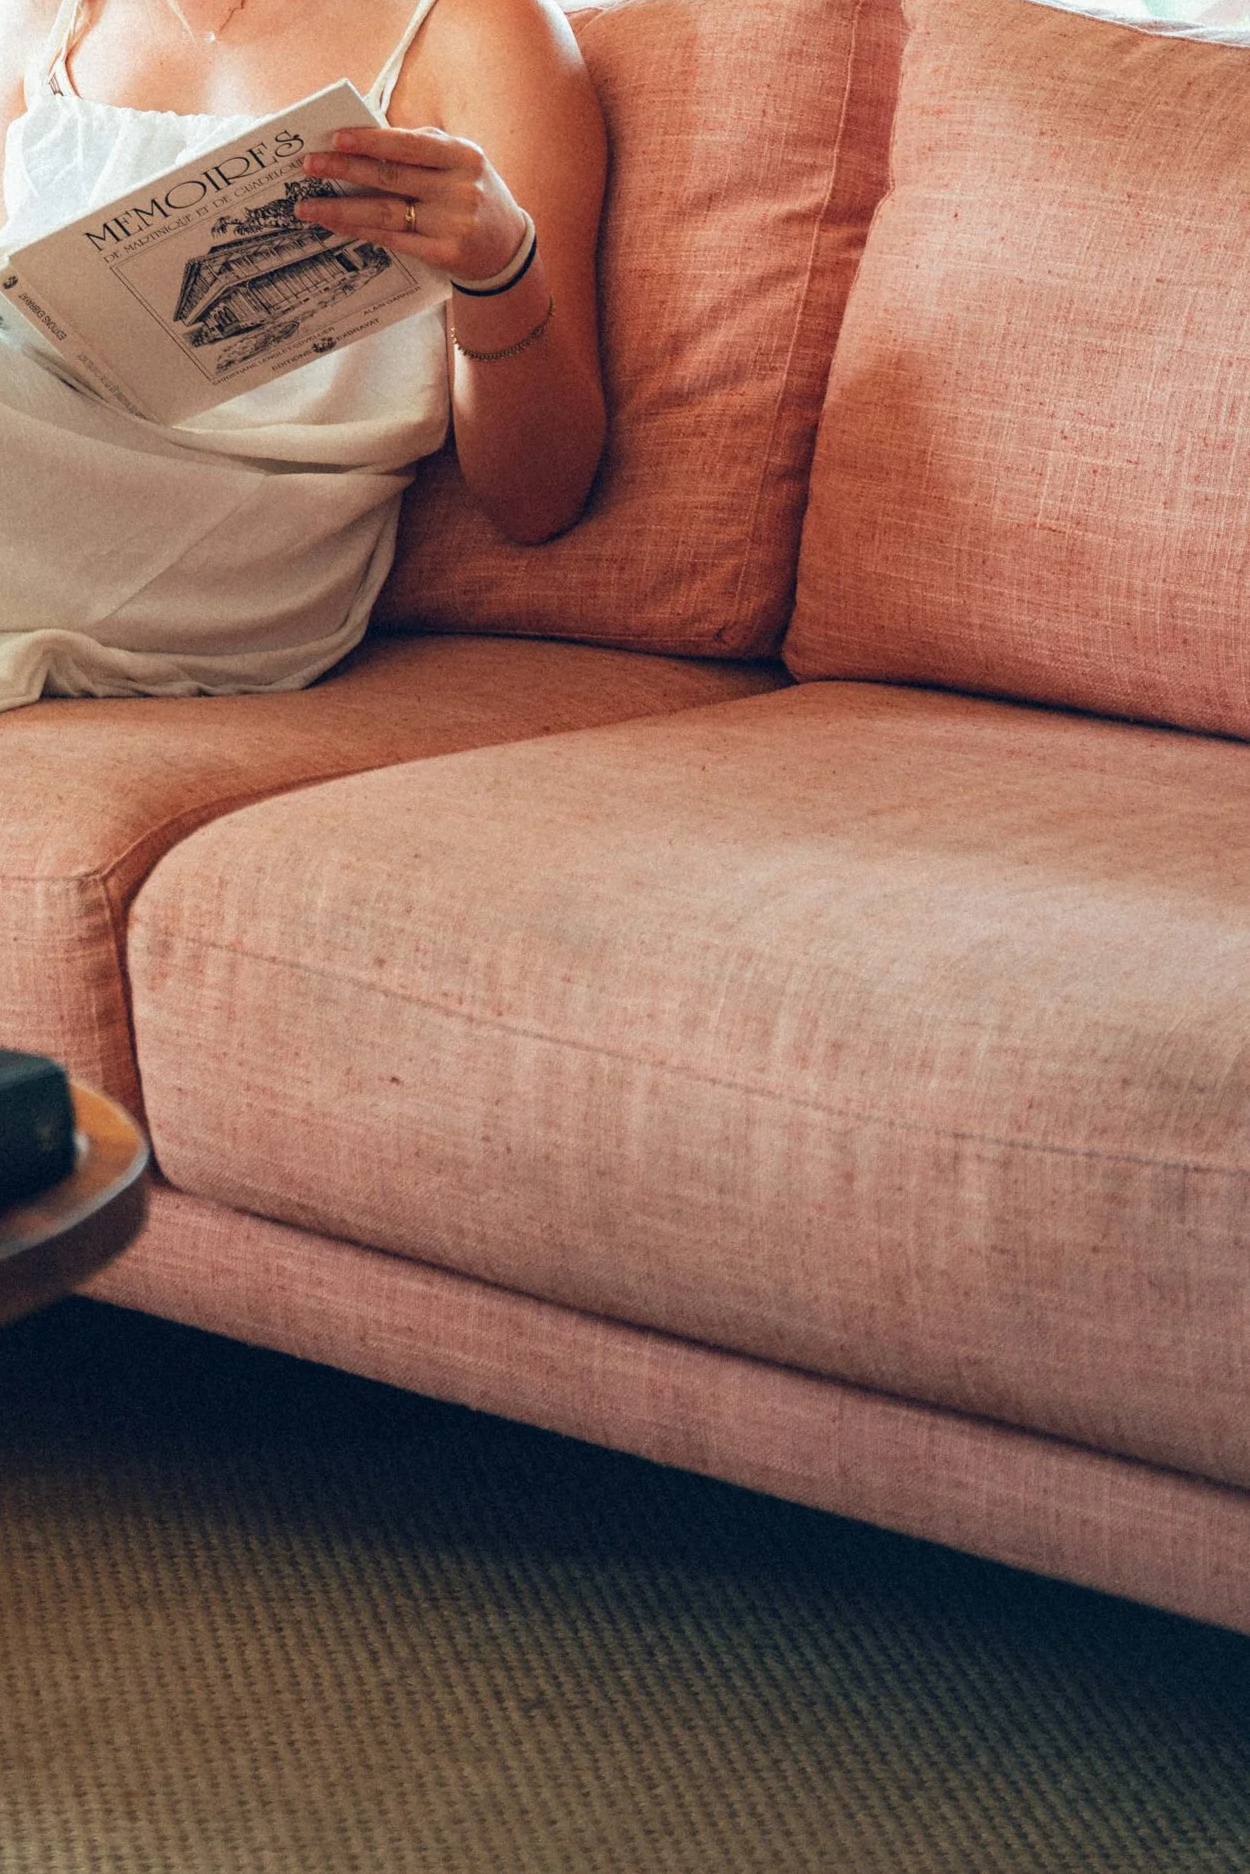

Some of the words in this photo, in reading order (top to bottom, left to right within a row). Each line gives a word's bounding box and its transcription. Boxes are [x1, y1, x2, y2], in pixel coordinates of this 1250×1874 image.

[84, 130, 306, 253] MEMOIRES
[102, 250, 122, 264] DE
[125, 213, 194, 255] MARTINIQUE
[196, 206, 211, 220] ET
[212, 196, 233, 210] DE
[18, 292, 47, 320] EXBRAYAT
[42, 315, 68, 342] EDITIONS
[270, 349, 313, 372] EDITIONS
[334, 316, 381, 342] EXBRAYAT
